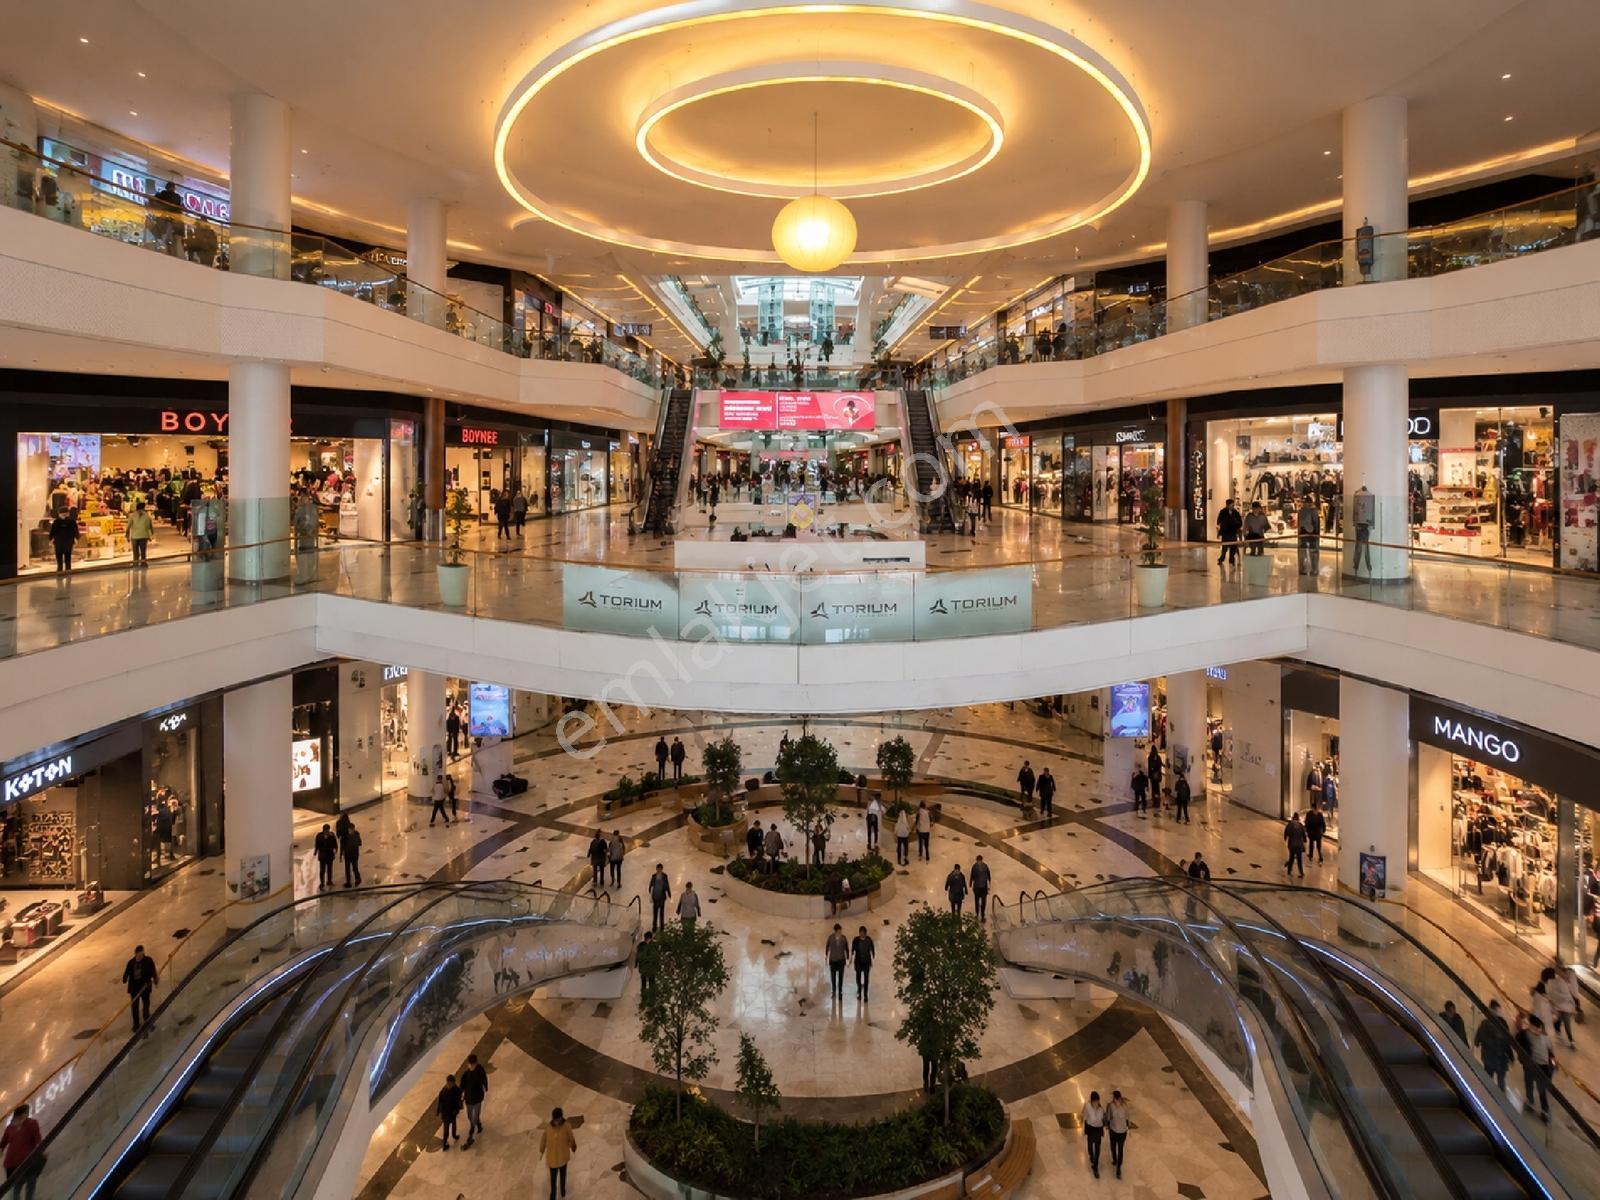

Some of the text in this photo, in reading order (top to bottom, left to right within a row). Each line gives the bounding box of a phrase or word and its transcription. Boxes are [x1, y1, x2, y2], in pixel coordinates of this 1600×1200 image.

[600, 594, 662, 610] TORIUM
[715, 602, 778, 615] TORIUM
[832, 602, 897, 614] TORIUM
[951, 595, 1017, 610] TORIUM
[1434, 715, 1519, 763] MANGO
[4, 755, 73, 801] KOTON
